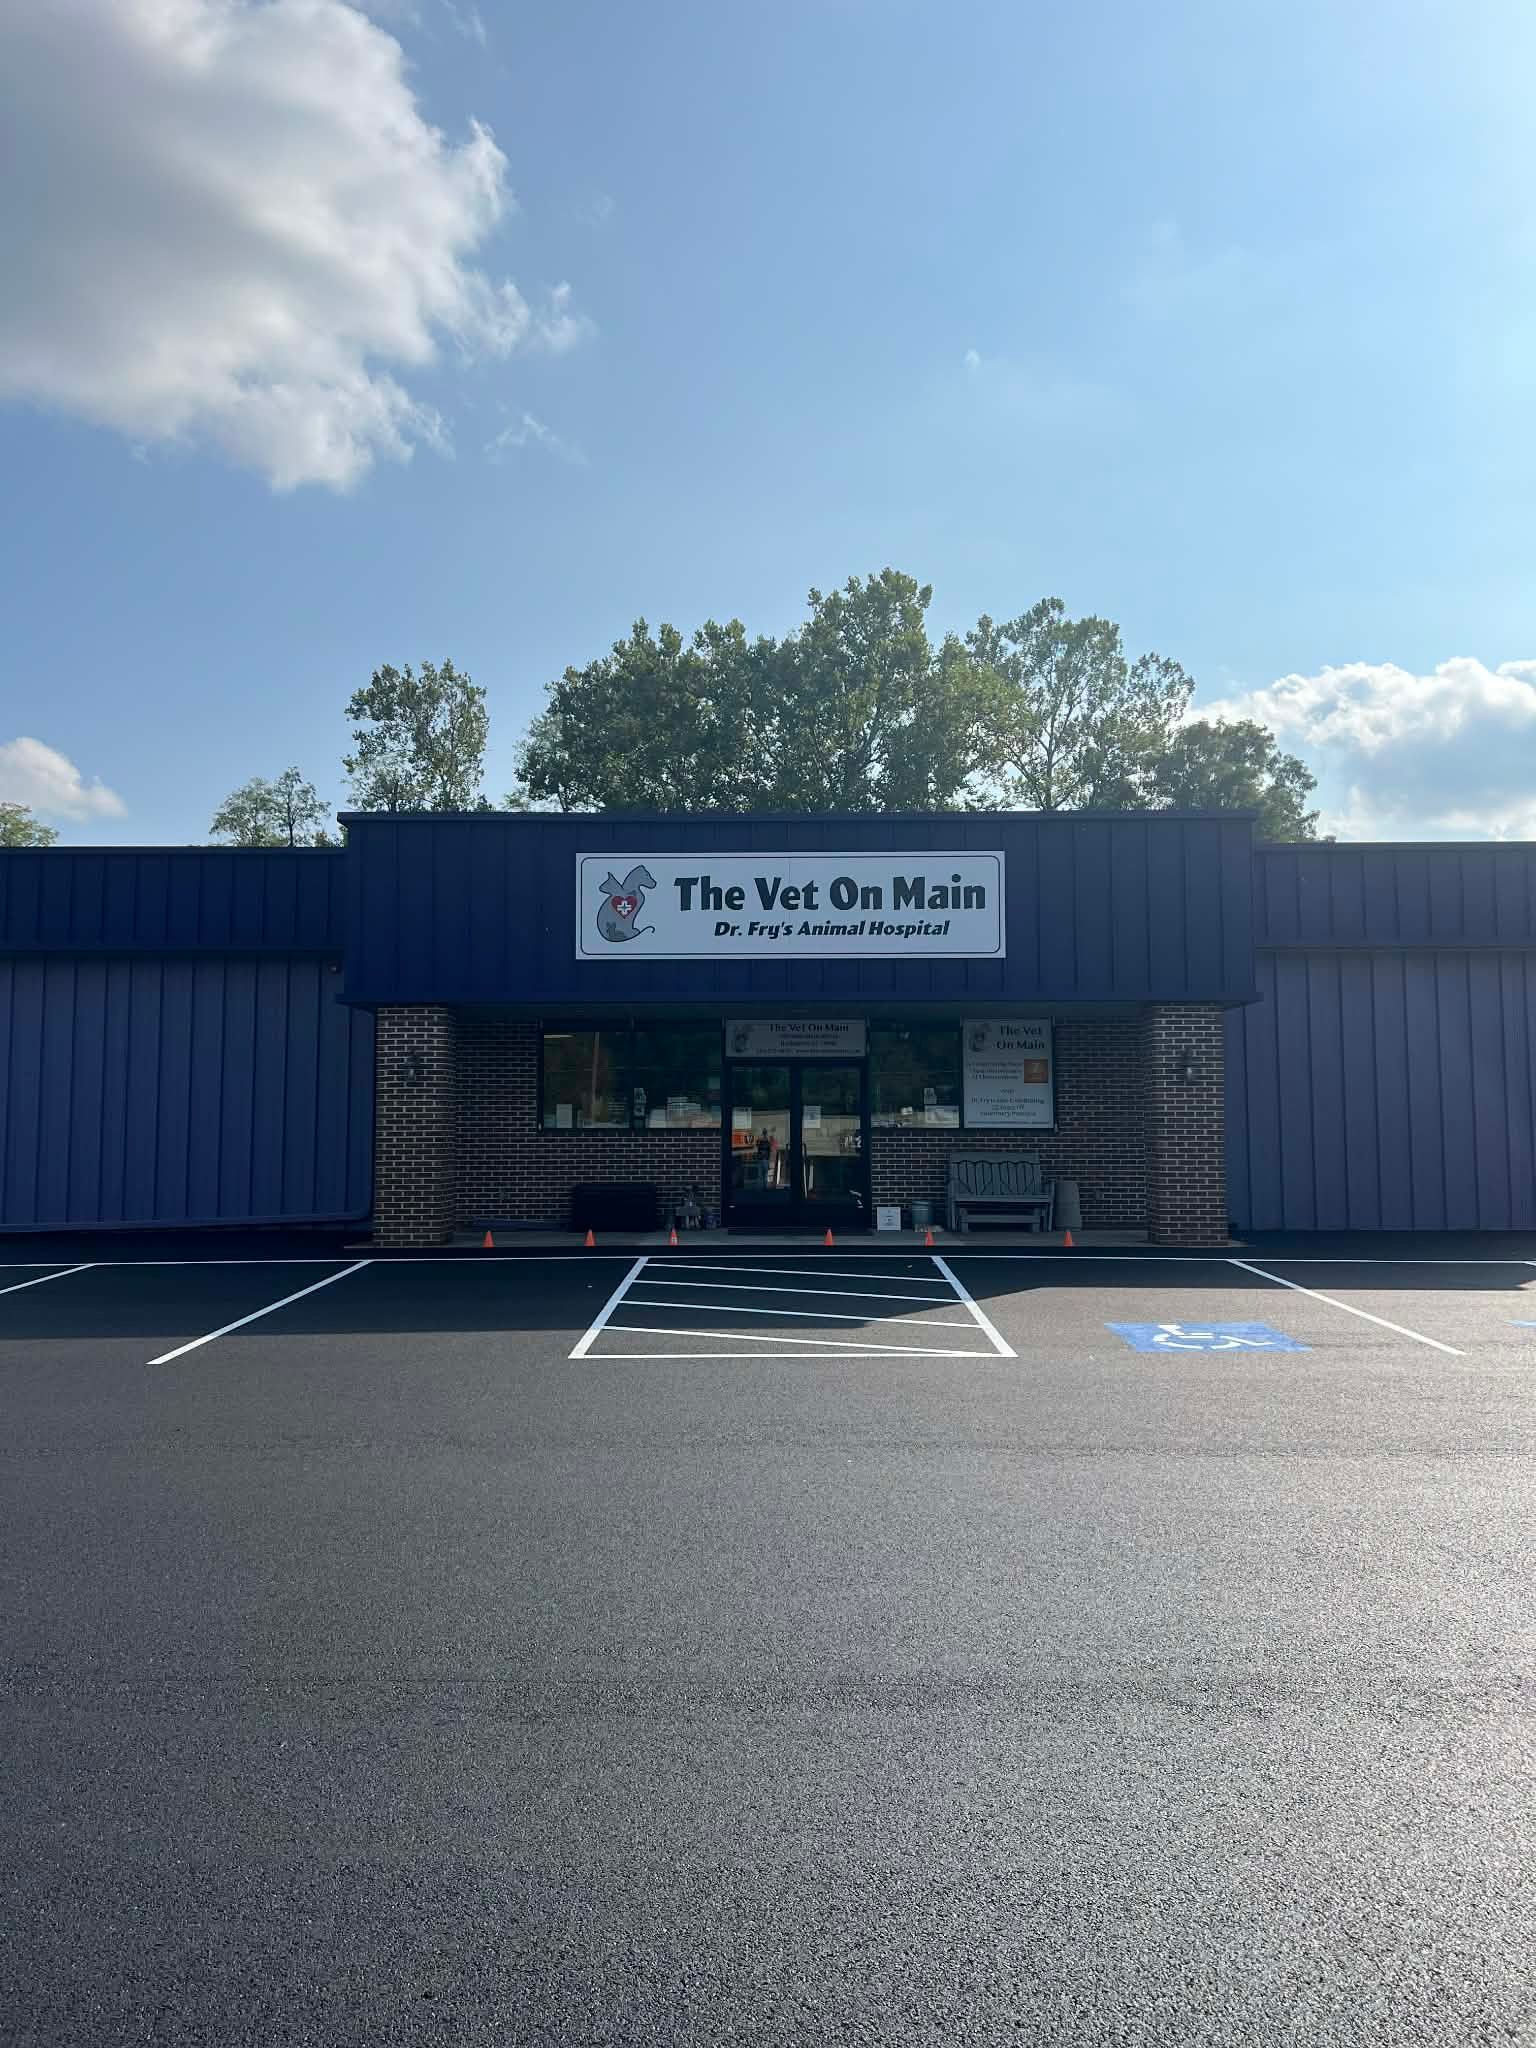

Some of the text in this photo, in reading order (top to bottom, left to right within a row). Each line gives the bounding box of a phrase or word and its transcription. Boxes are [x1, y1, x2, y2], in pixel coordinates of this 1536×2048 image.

[674, 874, 986, 912] The Vet On Main
[714, 919, 951, 940] Dr. Fry's Animal Hospital
[1000, 1024, 1041, 1036] The Vet
[996, 1039, 1045, 1050] On Main
